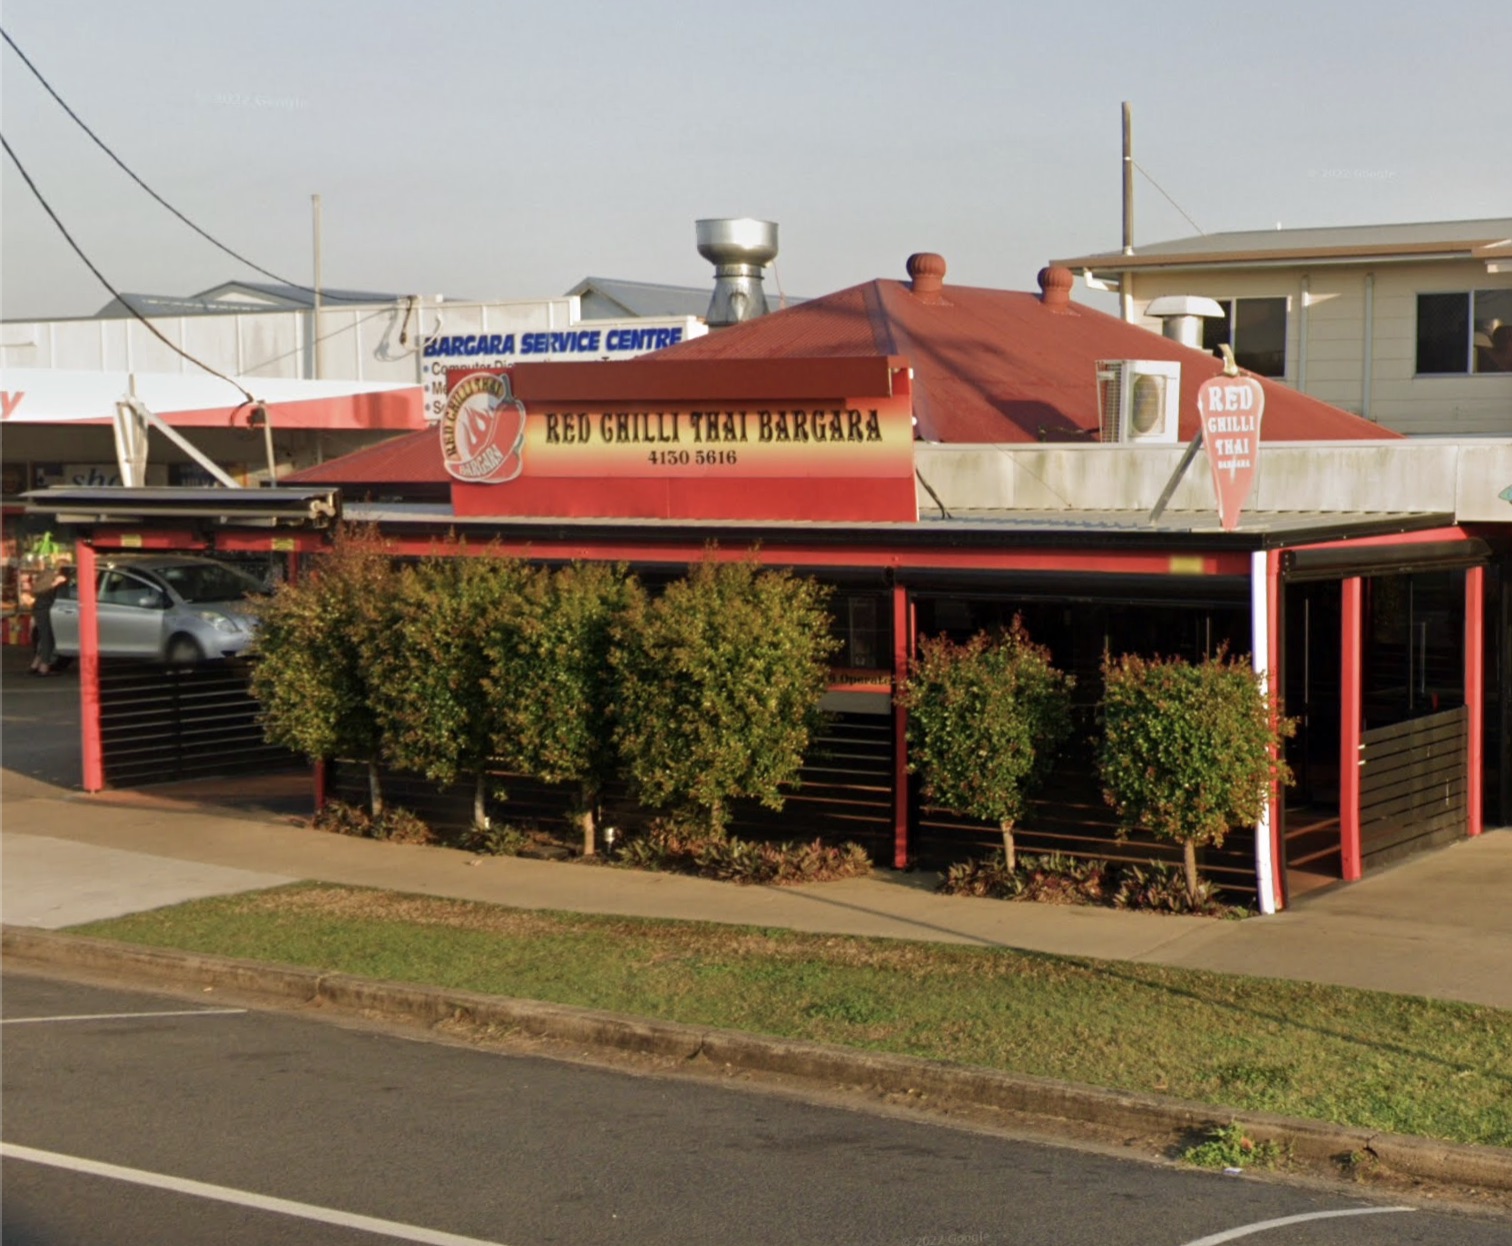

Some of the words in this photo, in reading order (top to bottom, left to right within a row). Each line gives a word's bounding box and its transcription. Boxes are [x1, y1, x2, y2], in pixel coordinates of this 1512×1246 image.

[423, 333, 515, 358] BARGARA
[521, 330, 602, 354] SERVICE
[605, 327, 683, 351] CENTRE
[1208, 385, 1254, 411] RED
[545, 410, 591, 444] RED
[601, 410, 681, 444] CHILLI
[690, 409, 748, 443] THAI
[758, 408, 883, 443] BARGARA
[1208, 416, 1255, 433] CHILLI
[1215, 438, 1250, 455] THAI
[459, 443, 505, 477] BARGARA
[648, 450, 690, 466] 4130
[695, 450, 738, 466] 5616
[840, 673, 892, 686] Operate
